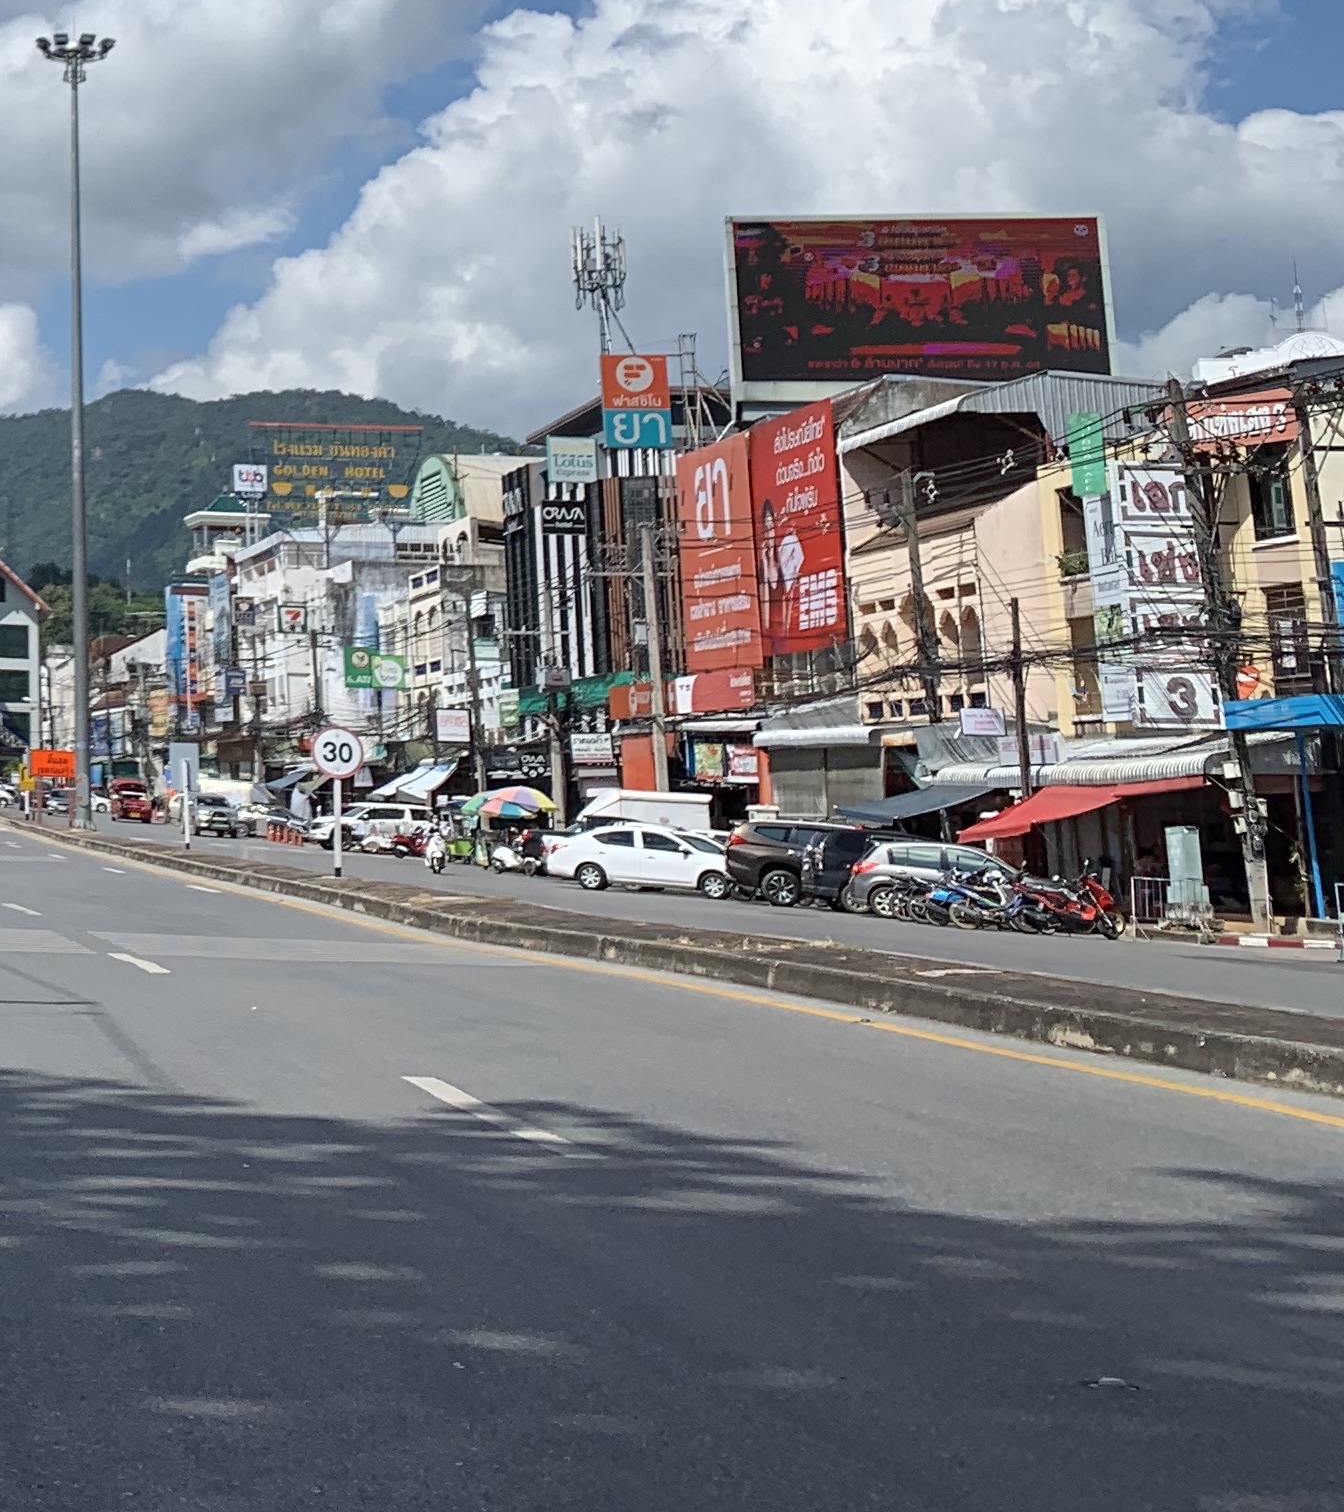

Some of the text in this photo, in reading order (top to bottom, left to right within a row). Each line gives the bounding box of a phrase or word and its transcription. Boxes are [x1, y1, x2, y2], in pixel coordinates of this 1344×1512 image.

[613, 413, 667, 444] ยา
[273, 464, 386, 478] GOLDEN HOTEL
[694, 457, 731, 539] ยา
[1166, 676, 1199, 720] 3
[322, 741, 353, 763] 30
